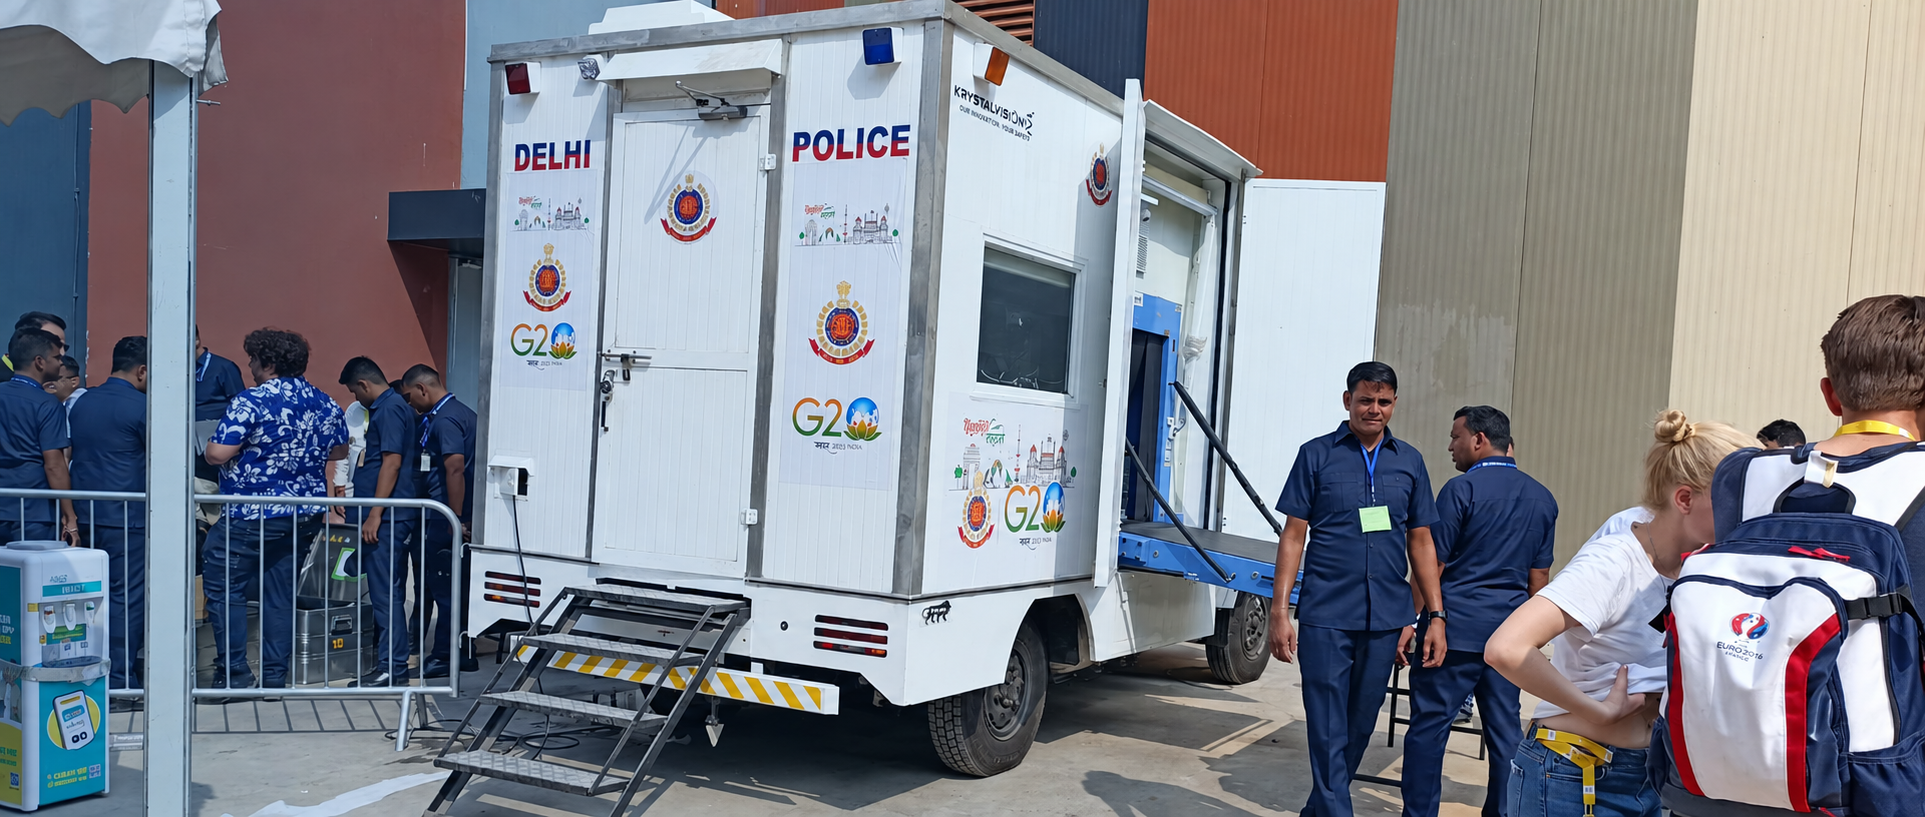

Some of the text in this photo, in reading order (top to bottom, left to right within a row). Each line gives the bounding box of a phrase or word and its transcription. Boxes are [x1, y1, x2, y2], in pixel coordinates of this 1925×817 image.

[954, 85, 1027, 128] KRYSTALVISION
[514, 124, 911, 171] DELHI POLICE
[511, 322, 577, 360] G20
[792, 397, 882, 441] G20
[1004, 481, 1066, 533] G20
